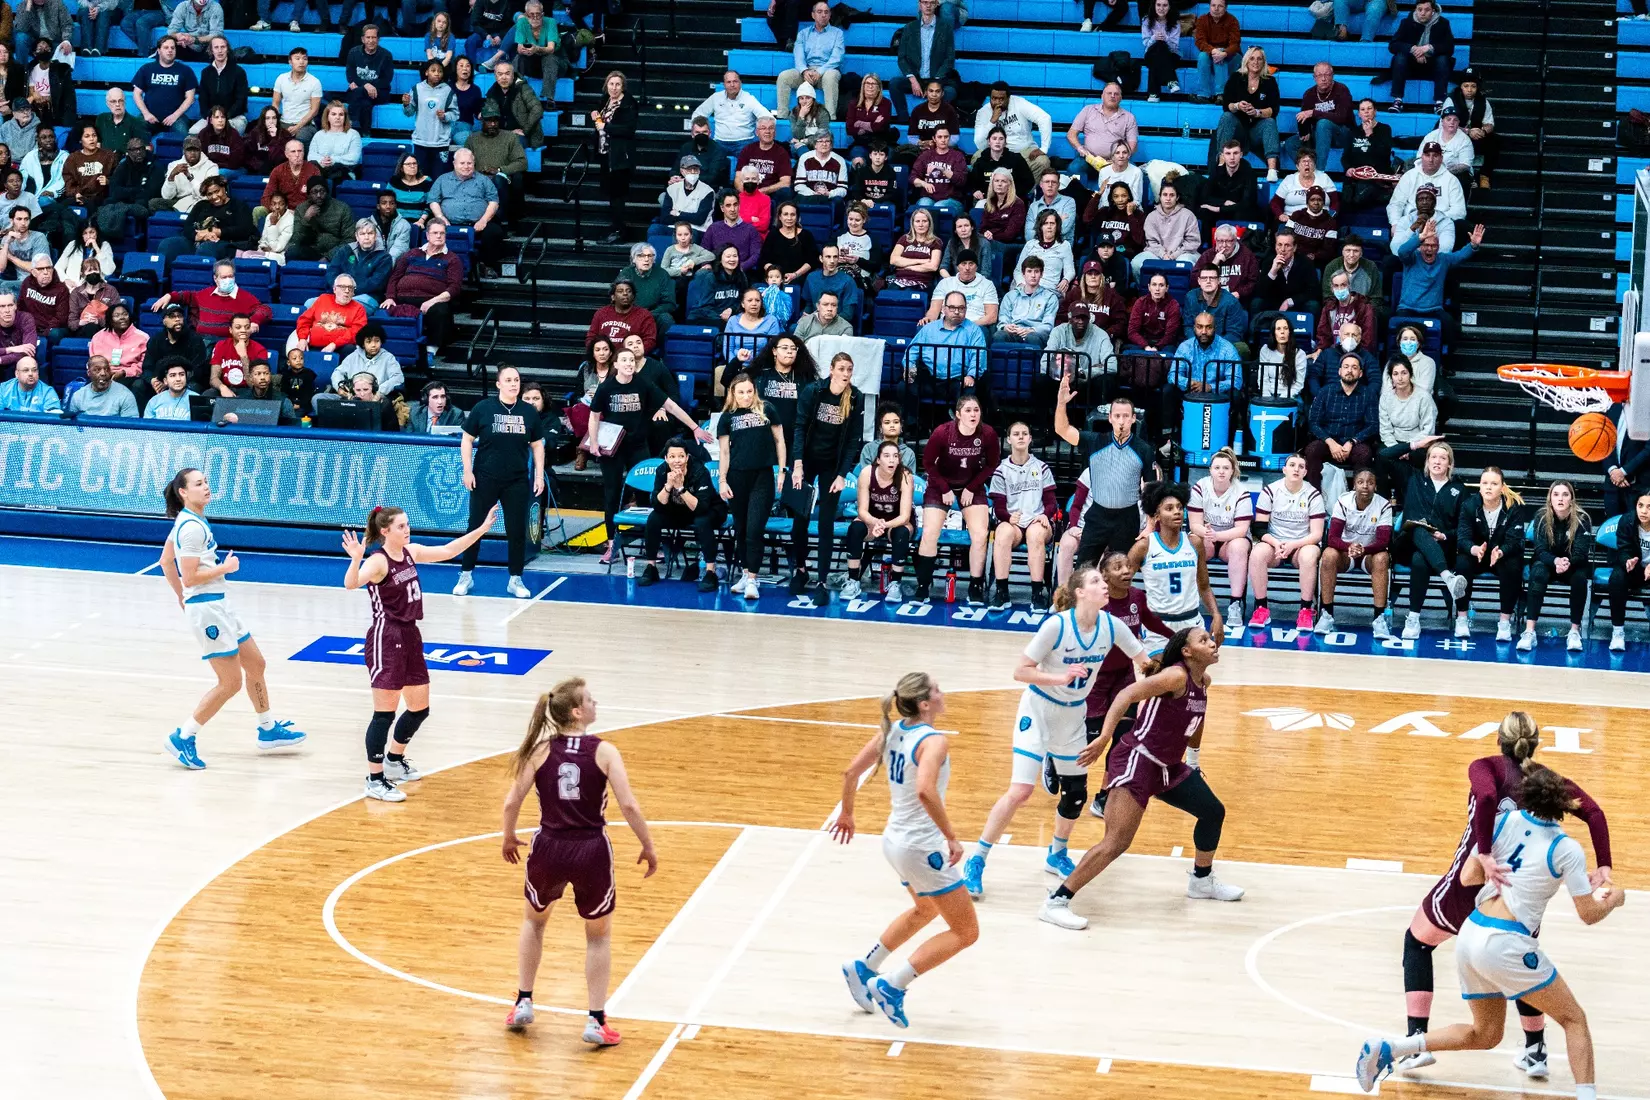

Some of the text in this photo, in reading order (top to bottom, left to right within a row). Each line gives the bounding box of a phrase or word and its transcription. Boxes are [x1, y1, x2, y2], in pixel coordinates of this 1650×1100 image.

[151, 73, 179, 83] LISTEN!
[26, 287, 57, 306] FORDHAM
[601, 320, 631, 332] FORDHAM
[610, 393, 640, 403] TOUGHER
[609, 403, 641, 413] TOGETHER
[493, 413, 524, 424] TOUGHER
[492, 423, 526, 434] TOGETHER
[959, 457, 968, 468] 1
[1152, 560, 1195, 571] COLUMBIA
[1168, 572, 1182, 594] 5
[405, 579, 422, 603] 13
[1062, 654, 1104, 664] COLUMBIA
[890, 750, 905, 784] 10
[558, 762, 581, 800] 2
[1507, 844, 1525, 873] 4
